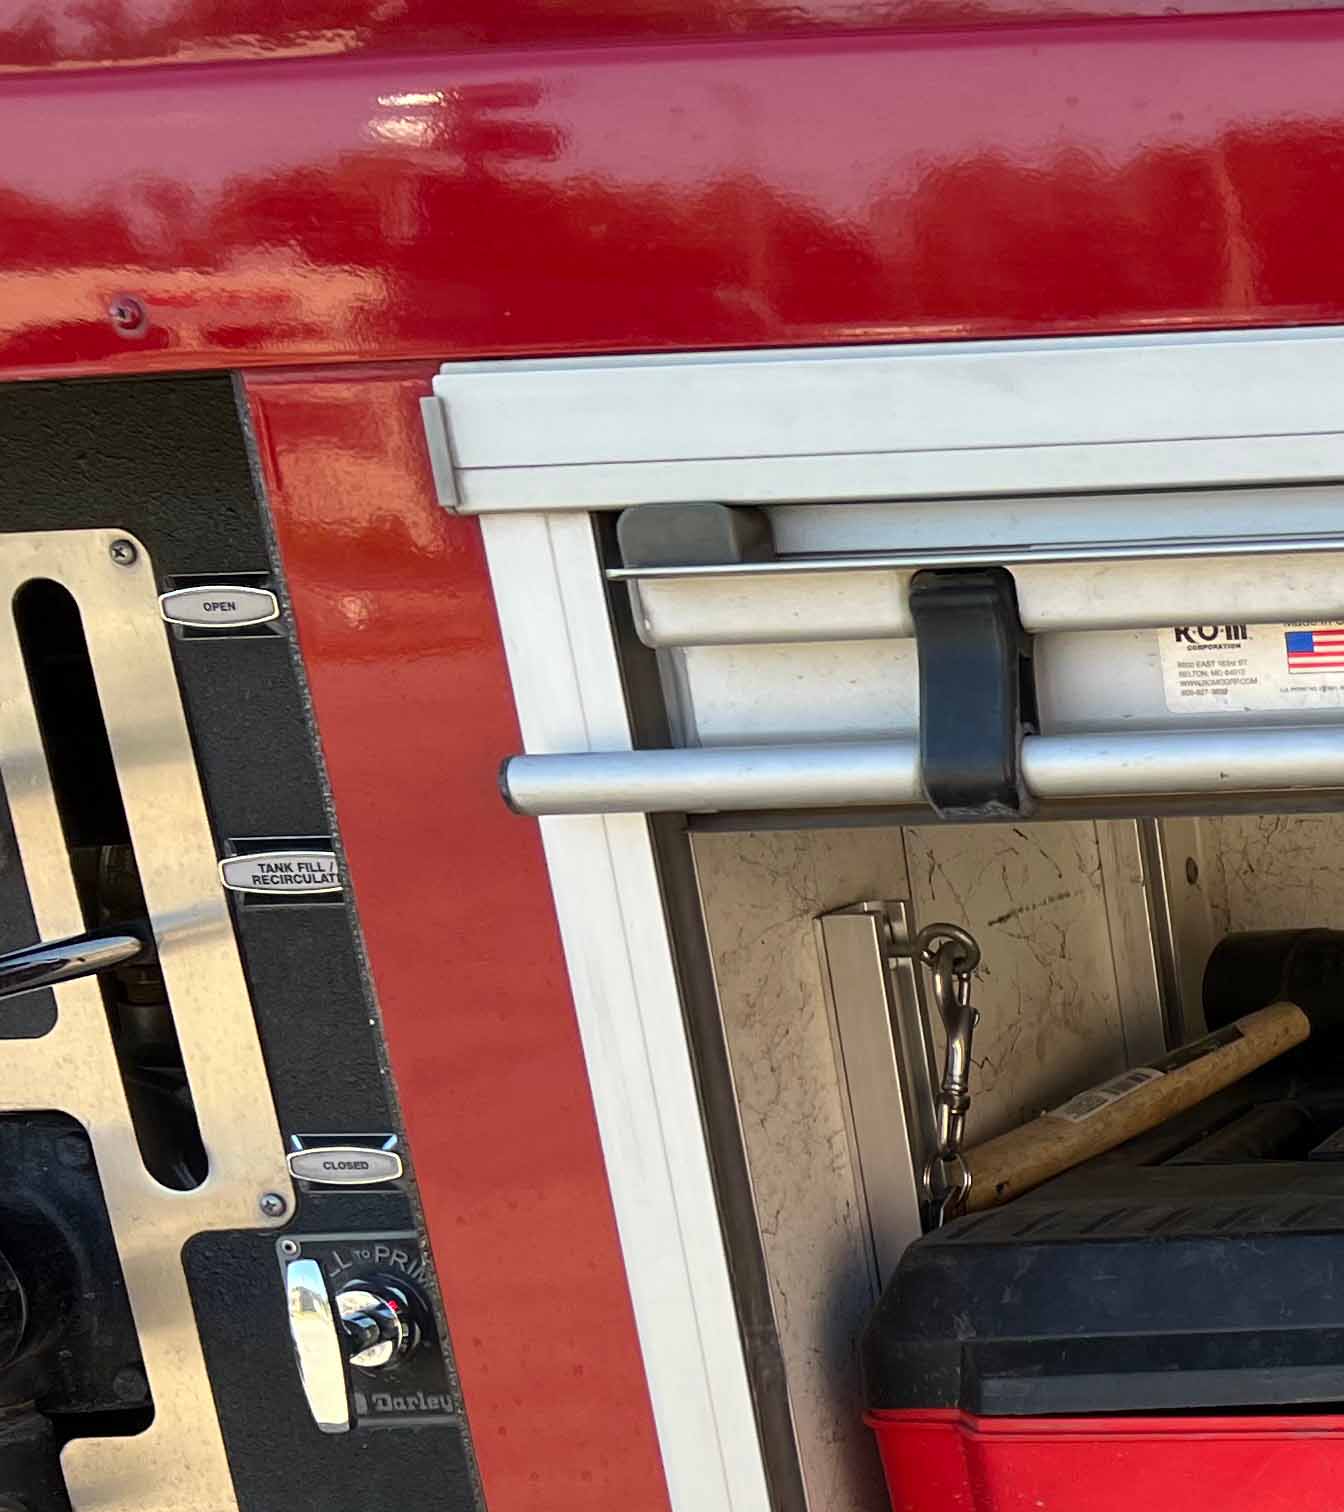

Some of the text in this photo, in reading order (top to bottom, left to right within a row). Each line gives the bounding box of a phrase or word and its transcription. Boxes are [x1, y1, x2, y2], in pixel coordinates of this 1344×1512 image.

[202, 602, 236, 612] OPEN
[258, 862, 294, 874] TANK
[297, 862, 326, 873] FILL
[323, 1161, 369, 1170] CLOSED
[353, 1250, 371, 1261] TO
[371, 1391, 452, 1412] Darley
